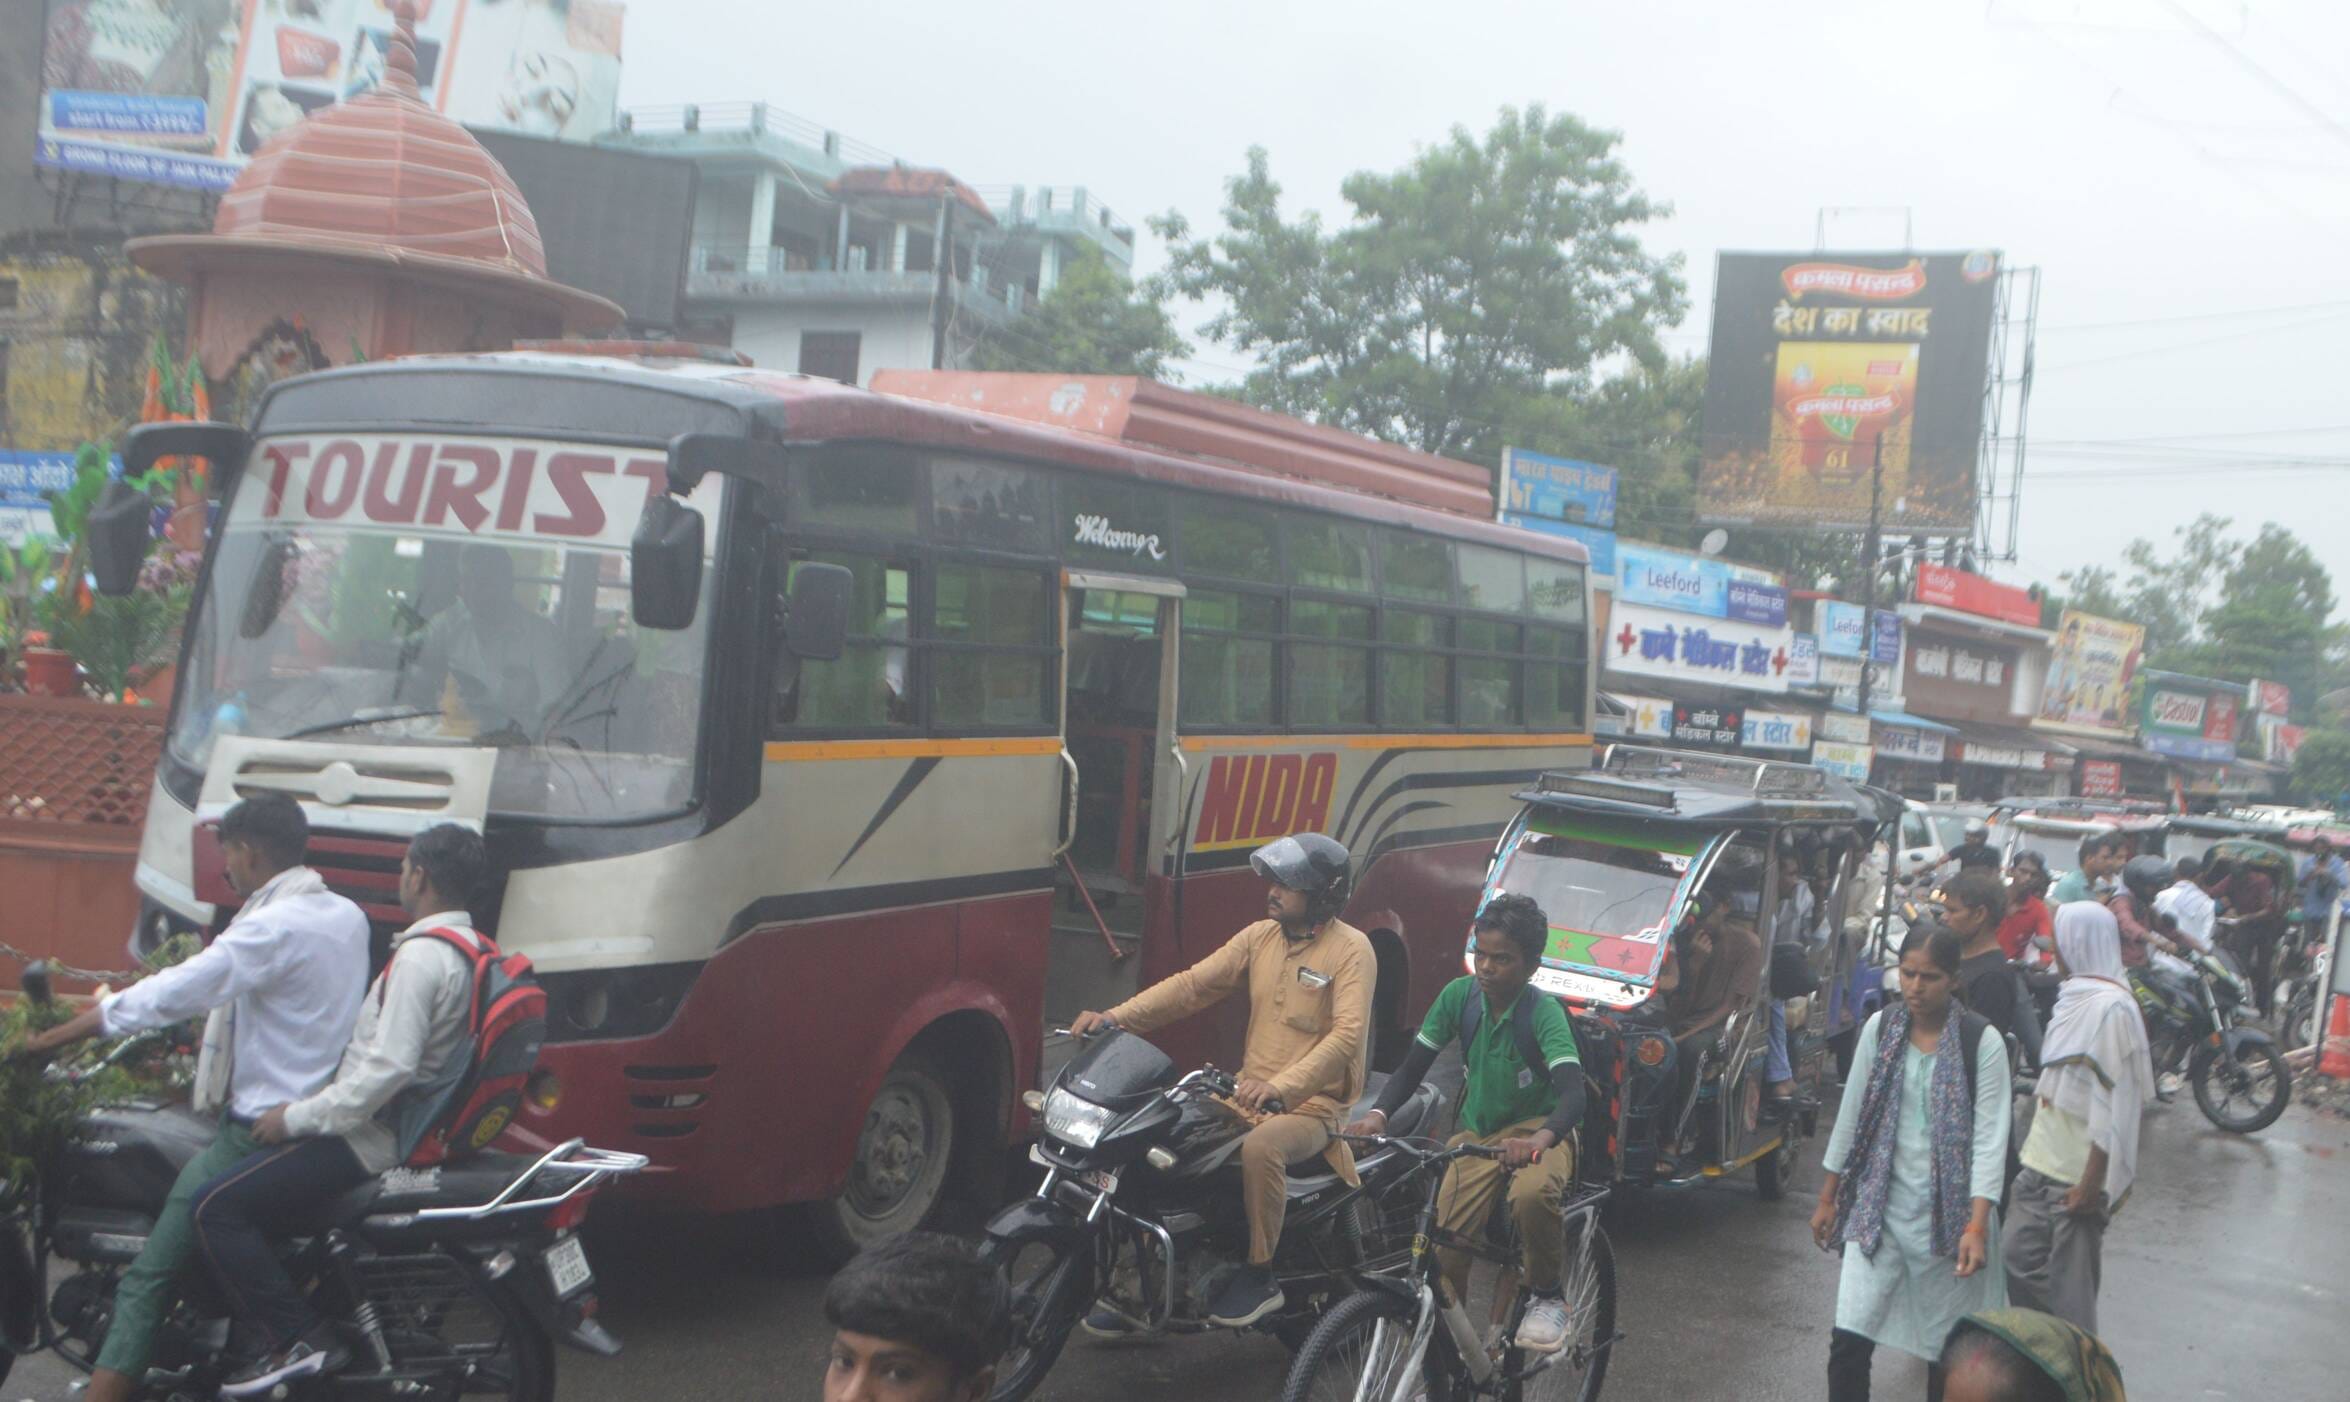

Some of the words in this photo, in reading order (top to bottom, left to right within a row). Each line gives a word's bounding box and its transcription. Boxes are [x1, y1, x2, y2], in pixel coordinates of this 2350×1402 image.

[1773, 299, 1818, 335] देश
[1824, 308, 1862, 335] का
[1867, 308, 1931, 337] स्वाद
[1826, 450, 1850, 469] 61
[1648, 567, 1700, 595] Leeford
[1834, 617, 1864, 635] Leefor
[1681, 626, 1739, 672] मेडिकल
[1741, 637, 1771, 677] स्टोर
[1714, 726, 1736, 743] स्टोर
[1762, 715, 1793, 745] स्टोर
[1194, 752, 1340, 852] NIDA
